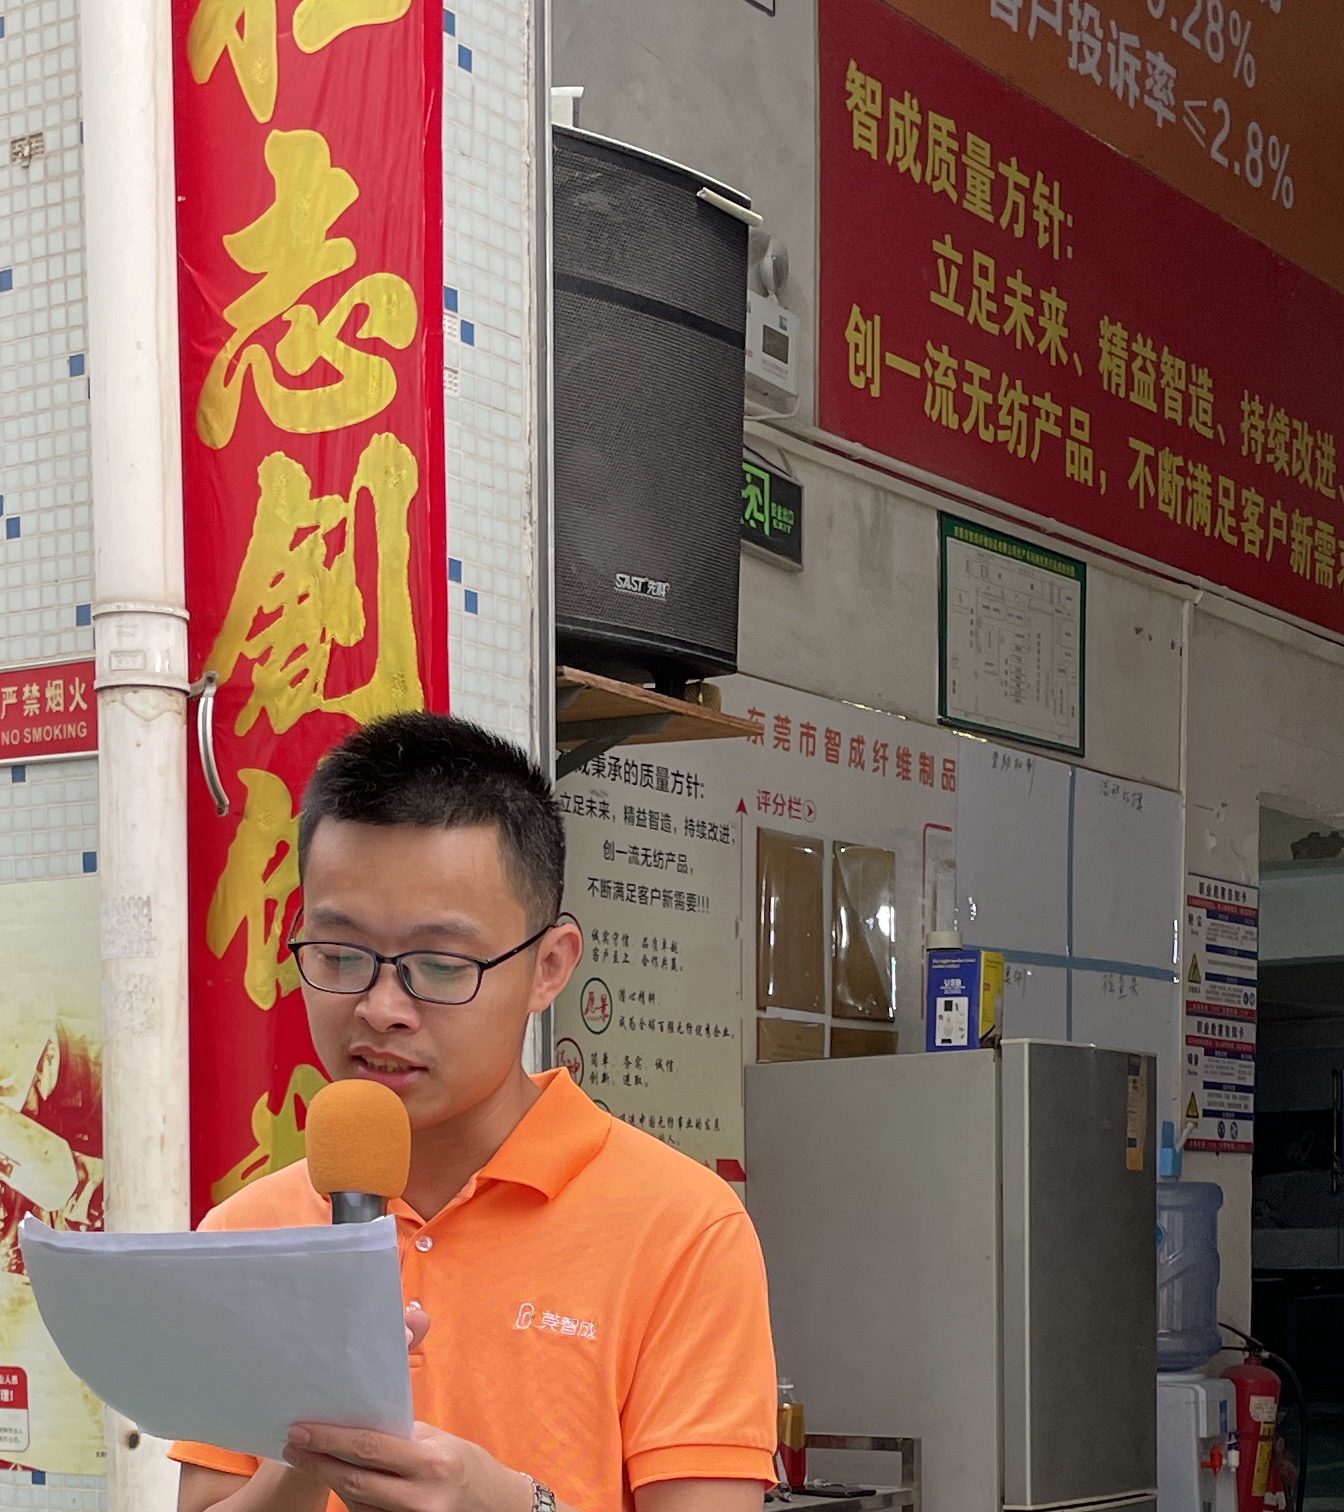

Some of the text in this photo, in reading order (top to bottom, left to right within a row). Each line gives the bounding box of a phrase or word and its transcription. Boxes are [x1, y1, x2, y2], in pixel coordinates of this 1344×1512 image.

[1147, 0, 1256, 88] .28%
[845, 60, 1075, 261] 智成质量方针:
[615, 573, 647, 592] SAST
[0, 676, 88, 720] 严禁烟火
[1, 721, 88, 746] NO SMOKING
[746, 706, 956, 793] 东莞市智成纤维制品
[756, 788, 802, 821] 评分栏
[603, 839, 694, 876] 创一流无纺产品，
